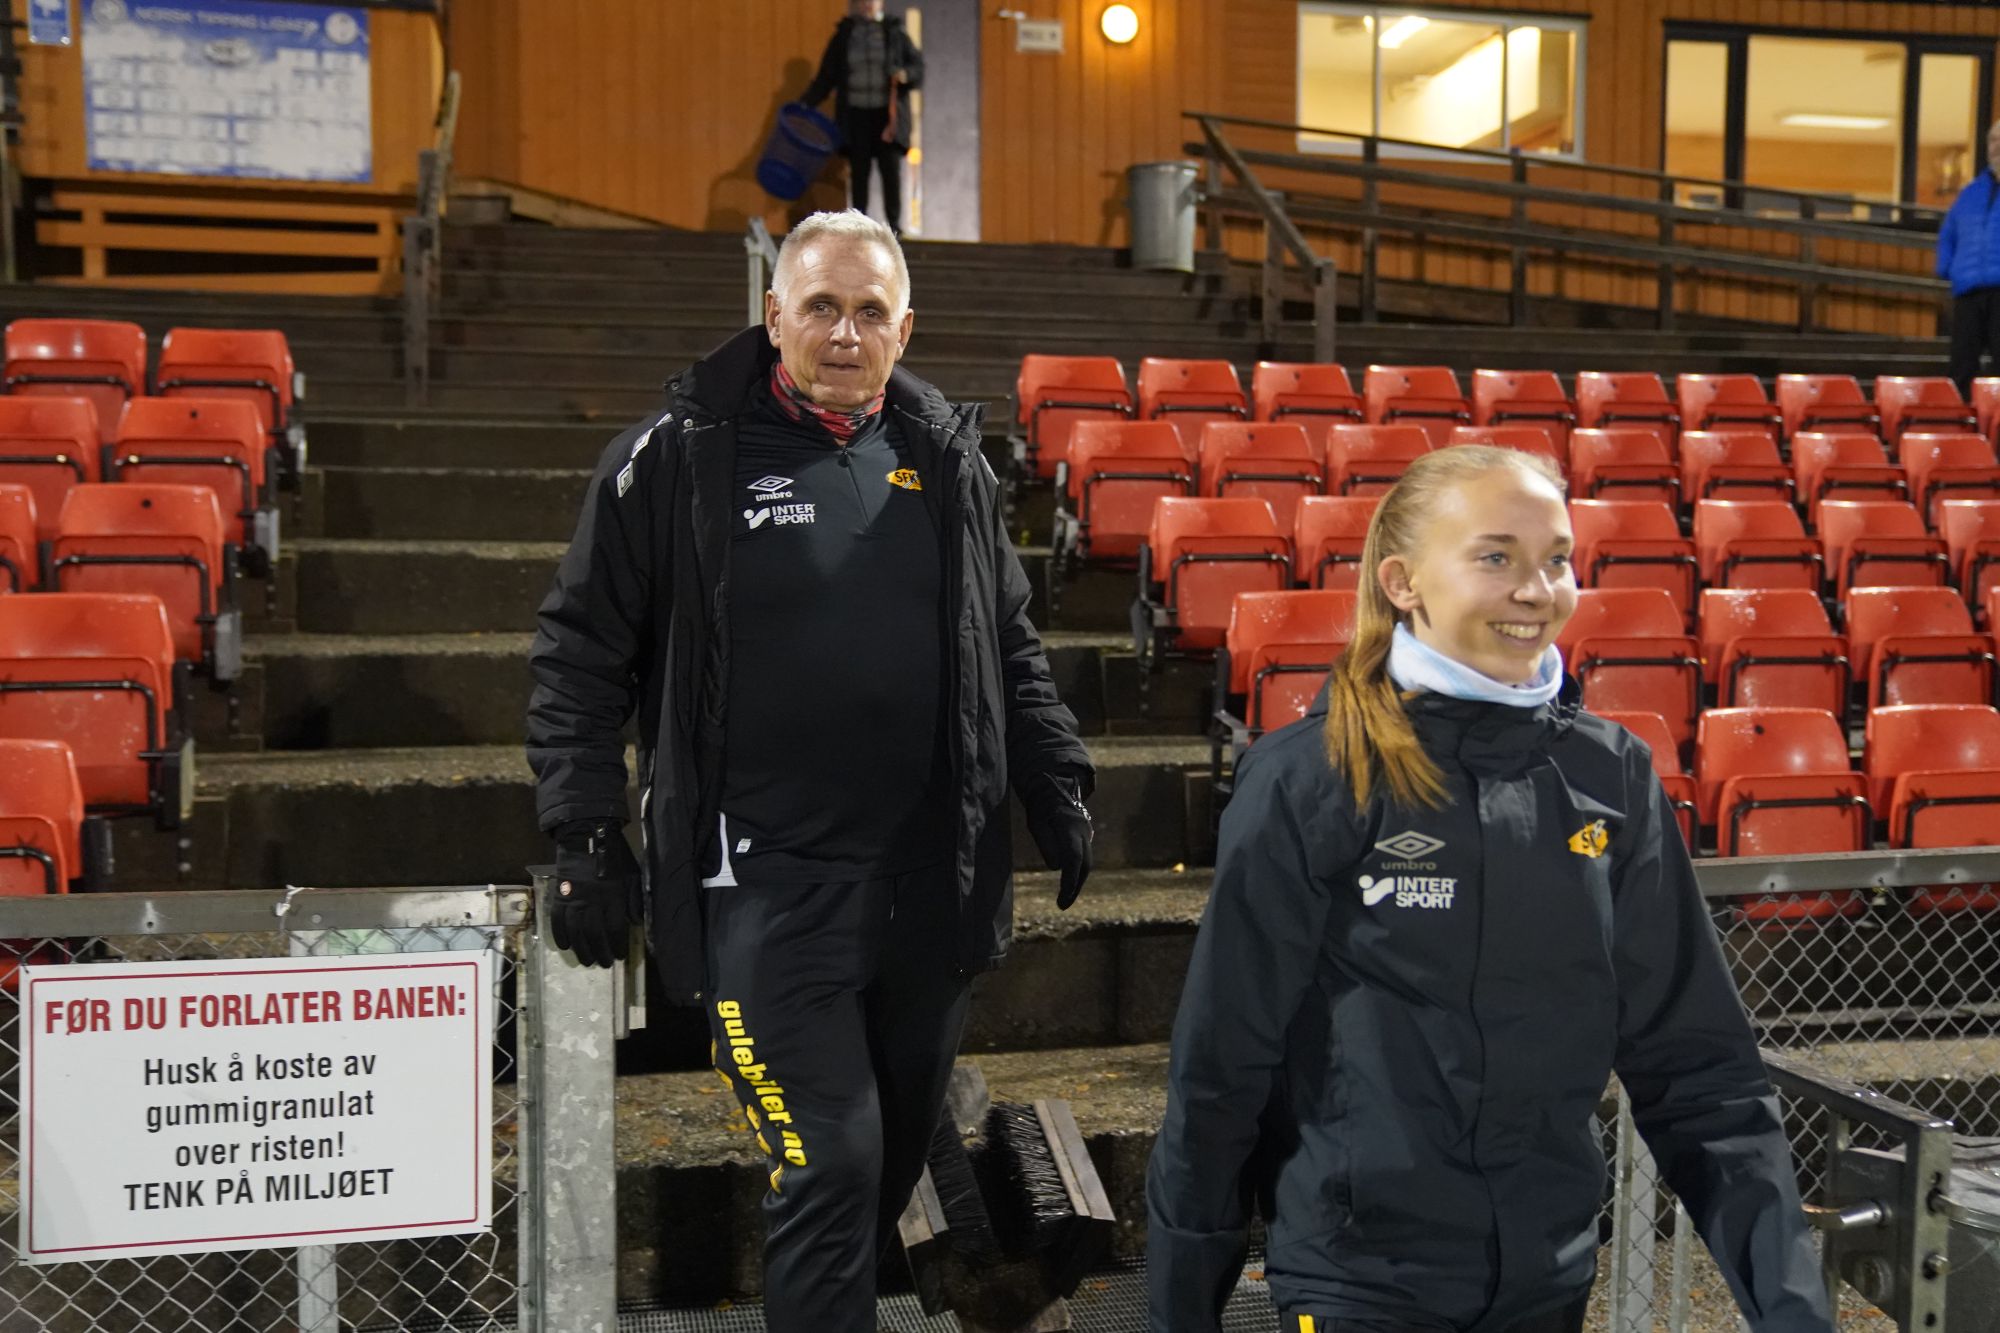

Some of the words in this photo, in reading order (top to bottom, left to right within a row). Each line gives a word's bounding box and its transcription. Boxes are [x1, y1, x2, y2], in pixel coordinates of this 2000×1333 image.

[755, 490, 793, 502] umbro
[772, 503, 815, 516] INTER
[774, 513, 816, 526] SPORT
[1381, 859, 1437, 871] umbro
[1397, 876, 1455, 893] INTER
[1396, 892, 1454, 909] SPORT
[45, 997, 111, 1036] FØR
[123, 997, 168, 1031] DU
[179, 990, 341, 1028] FORLATER
[353, 984, 466, 1021] BANEN:
[144, 1056, 217, 1086] Husk
[228, 1052, 244, 1082] å
[256, 1053, 332, 1081] koste
[344, 1054, 376, 1077] av
[146, 1090, 374, 1133] gummigranulat
[175, 1143, 240, 1167] over
[251, 1131, 344, 1163] risten!
[123, 1180, 205, 1211] TENK
[216, 1169, 254, 1205] PÅ
[265, 1168, 394, 1203] MILJØET
